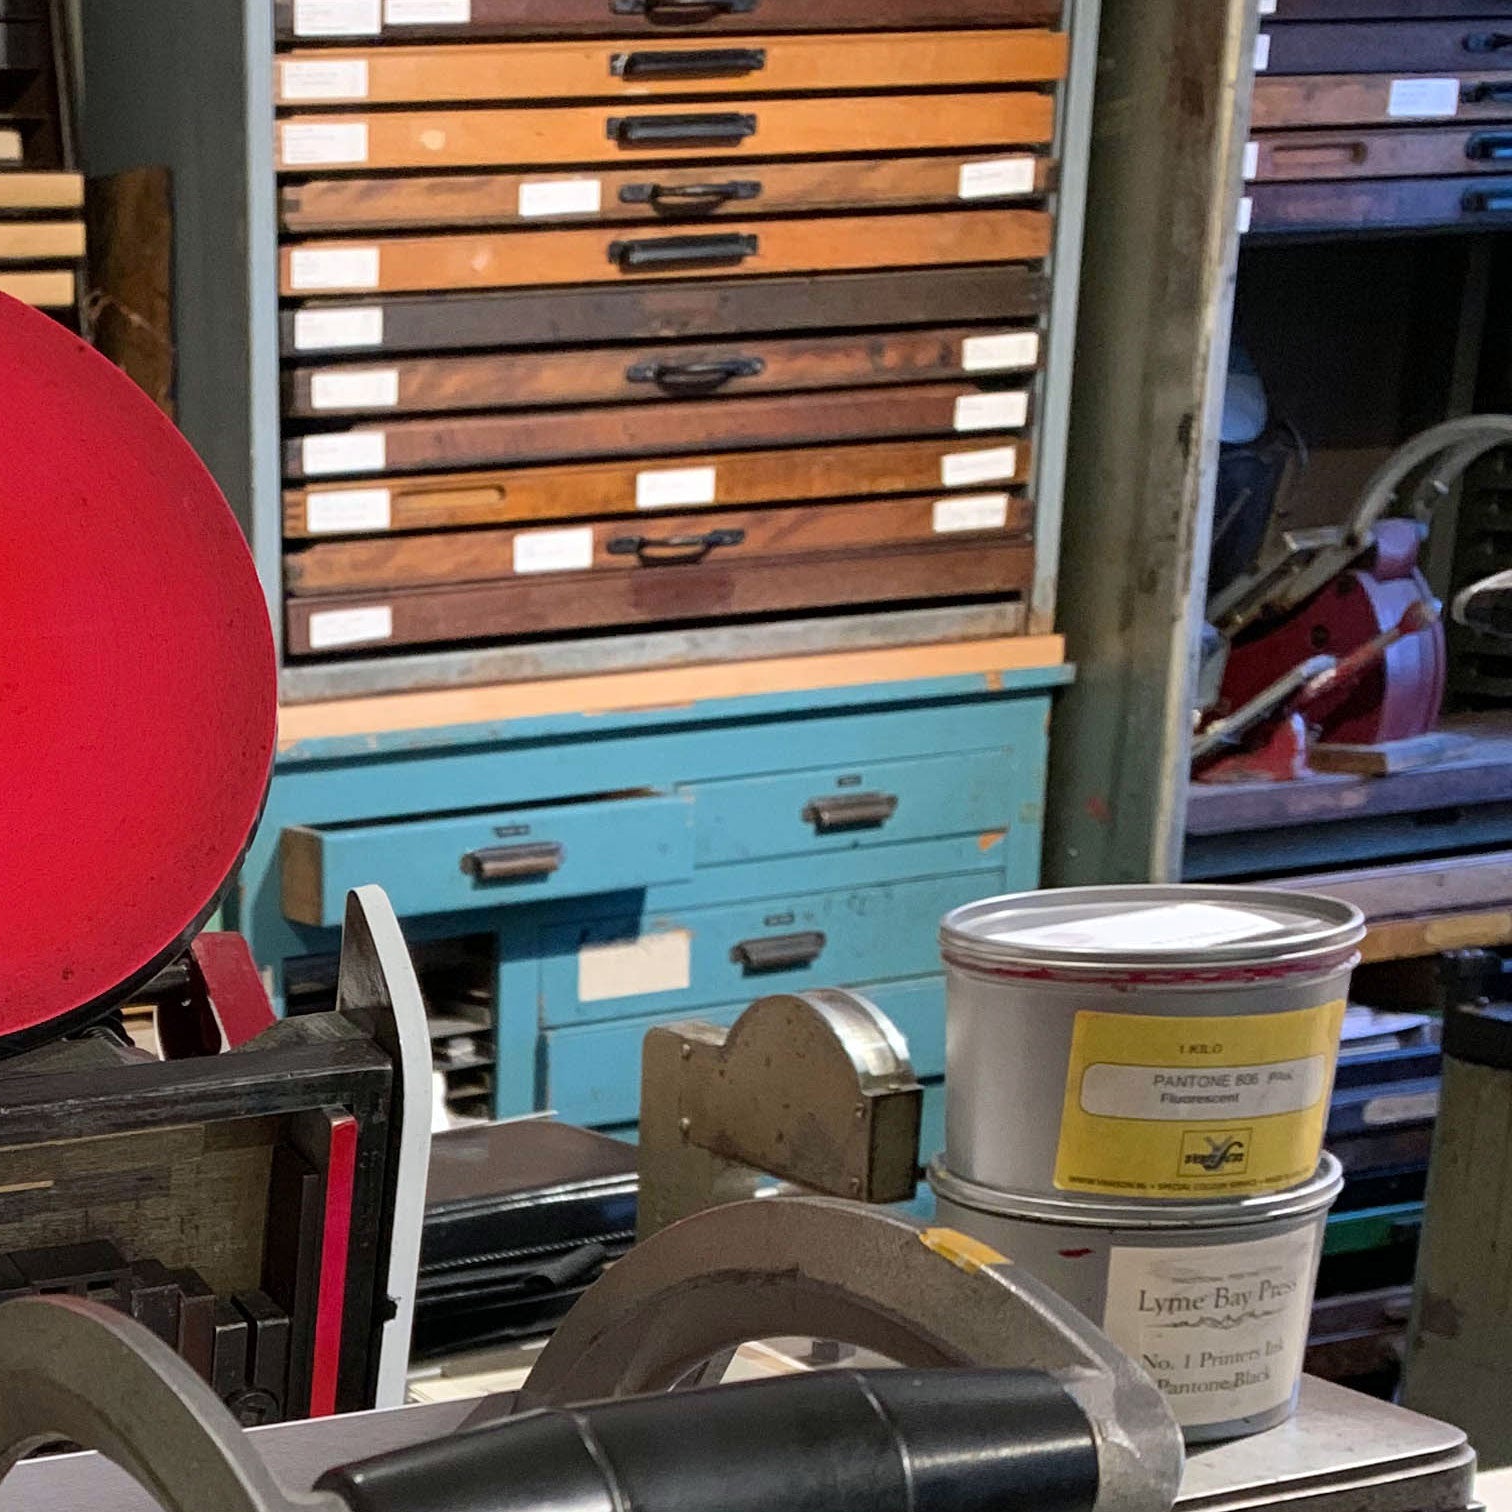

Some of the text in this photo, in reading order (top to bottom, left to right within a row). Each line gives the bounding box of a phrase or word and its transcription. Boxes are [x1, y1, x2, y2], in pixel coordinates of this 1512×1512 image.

[1152, 1073, 1231, 1088] PANTONE
[1159, 1092, 1240, 1104] Fluorescent
[1138, 1279, 1298, 1316] Lyme Bay Press
[1142, 1353, 1175, 1371] No.
[1199, 1349, 1262, 1368] Printers
[1156, 1371, 1271, 1396] Pantone Black
